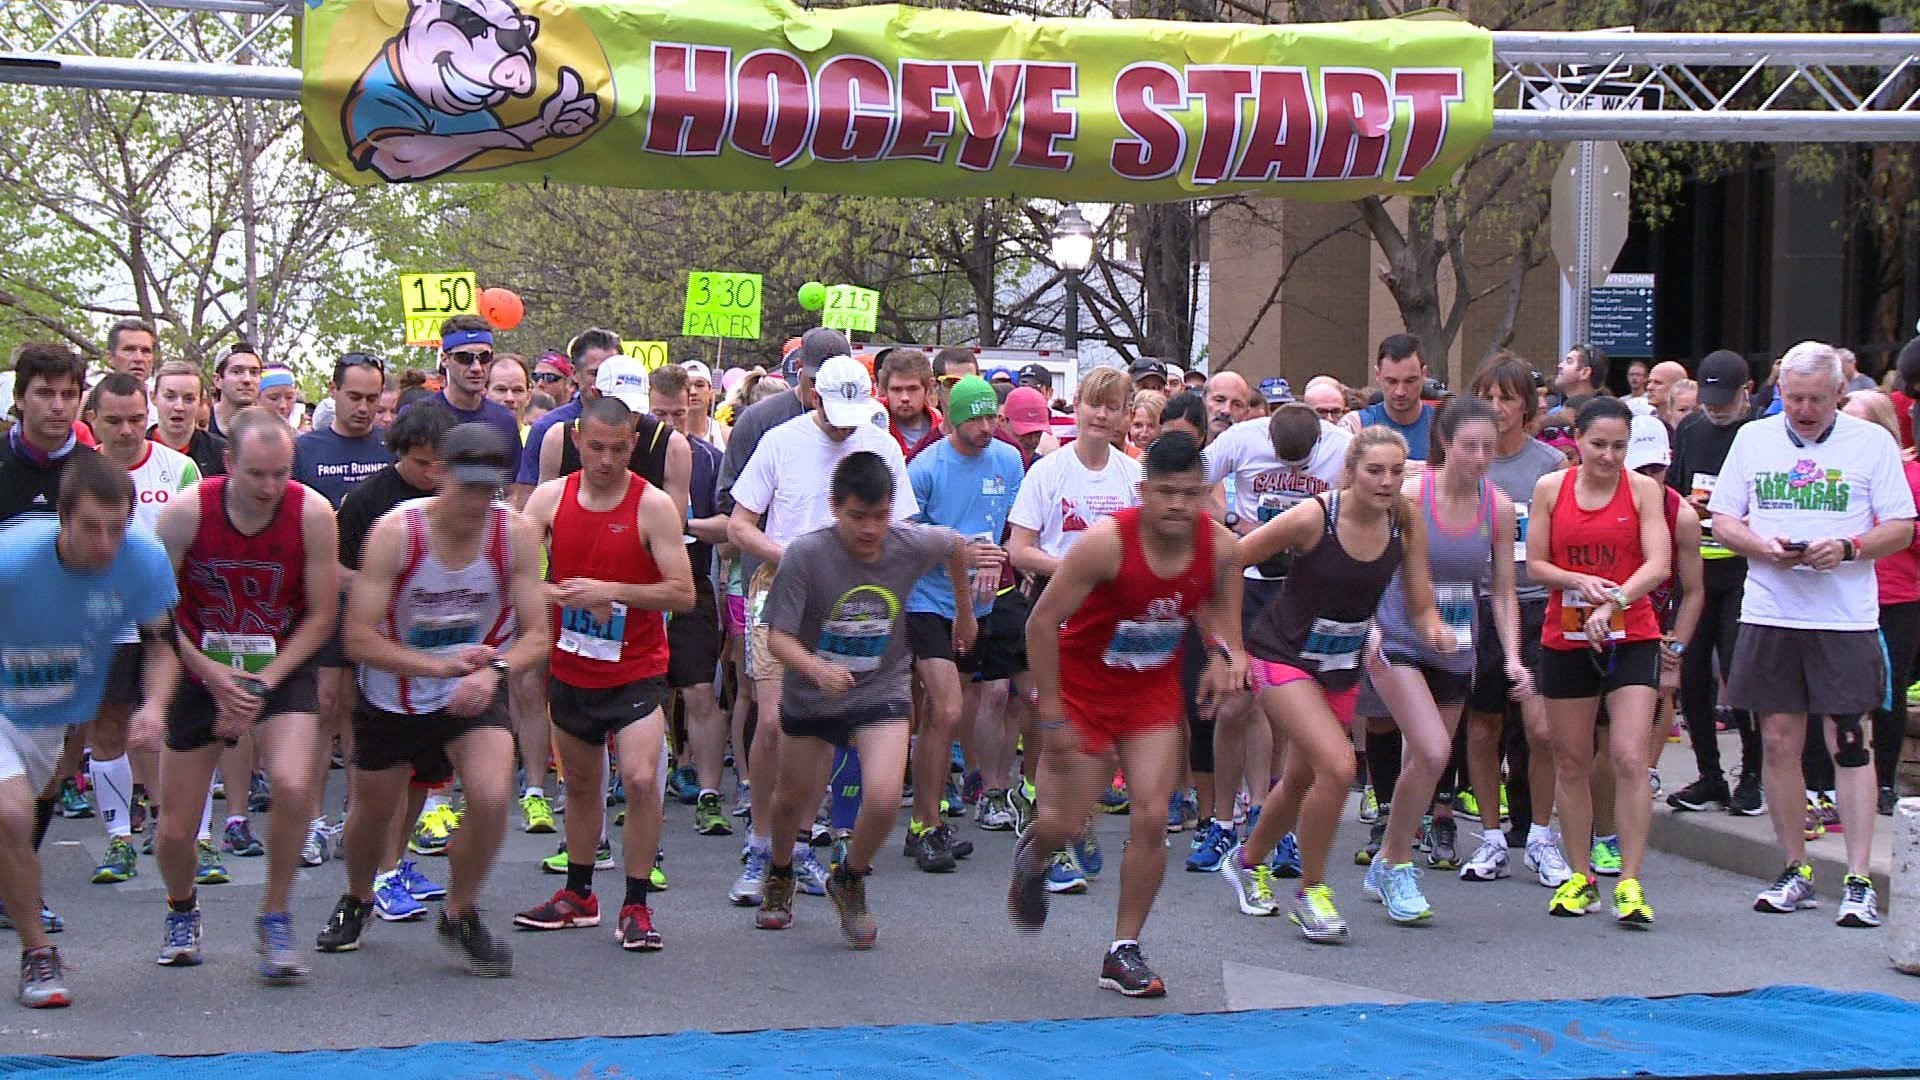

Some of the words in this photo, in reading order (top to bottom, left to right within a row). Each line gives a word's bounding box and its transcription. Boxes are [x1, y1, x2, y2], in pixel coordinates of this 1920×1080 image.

[642, 40, 1078, 172] HOGEYE
[1109, 61, 1465, 184] START
[688, 313, 753, 337] PACER
[317, 464, 349, 477] FRONT
[1567, 543, 1616, 567] RUN
